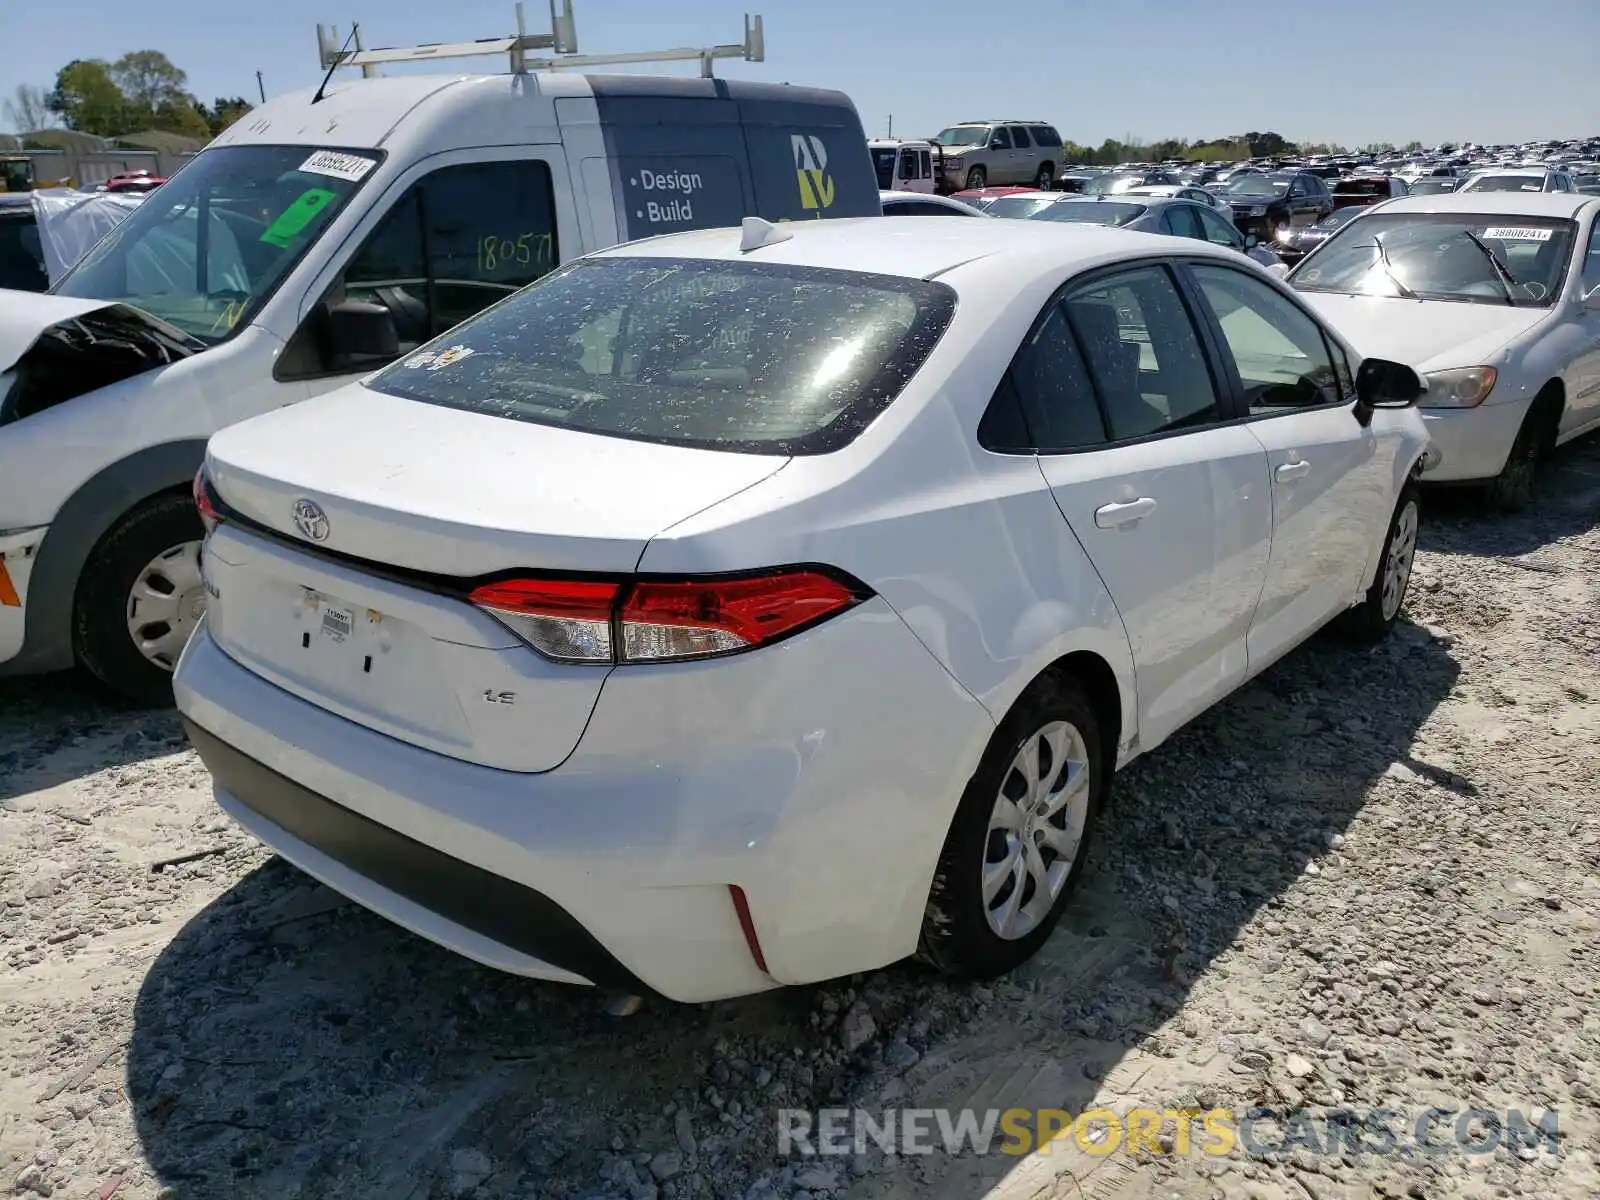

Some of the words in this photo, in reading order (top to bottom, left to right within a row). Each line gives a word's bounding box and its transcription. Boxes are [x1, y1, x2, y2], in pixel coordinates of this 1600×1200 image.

[641, 170, 702, 193] Design
[648, 200, 693, 222] Build
[484, 690, 515, 705] LE
